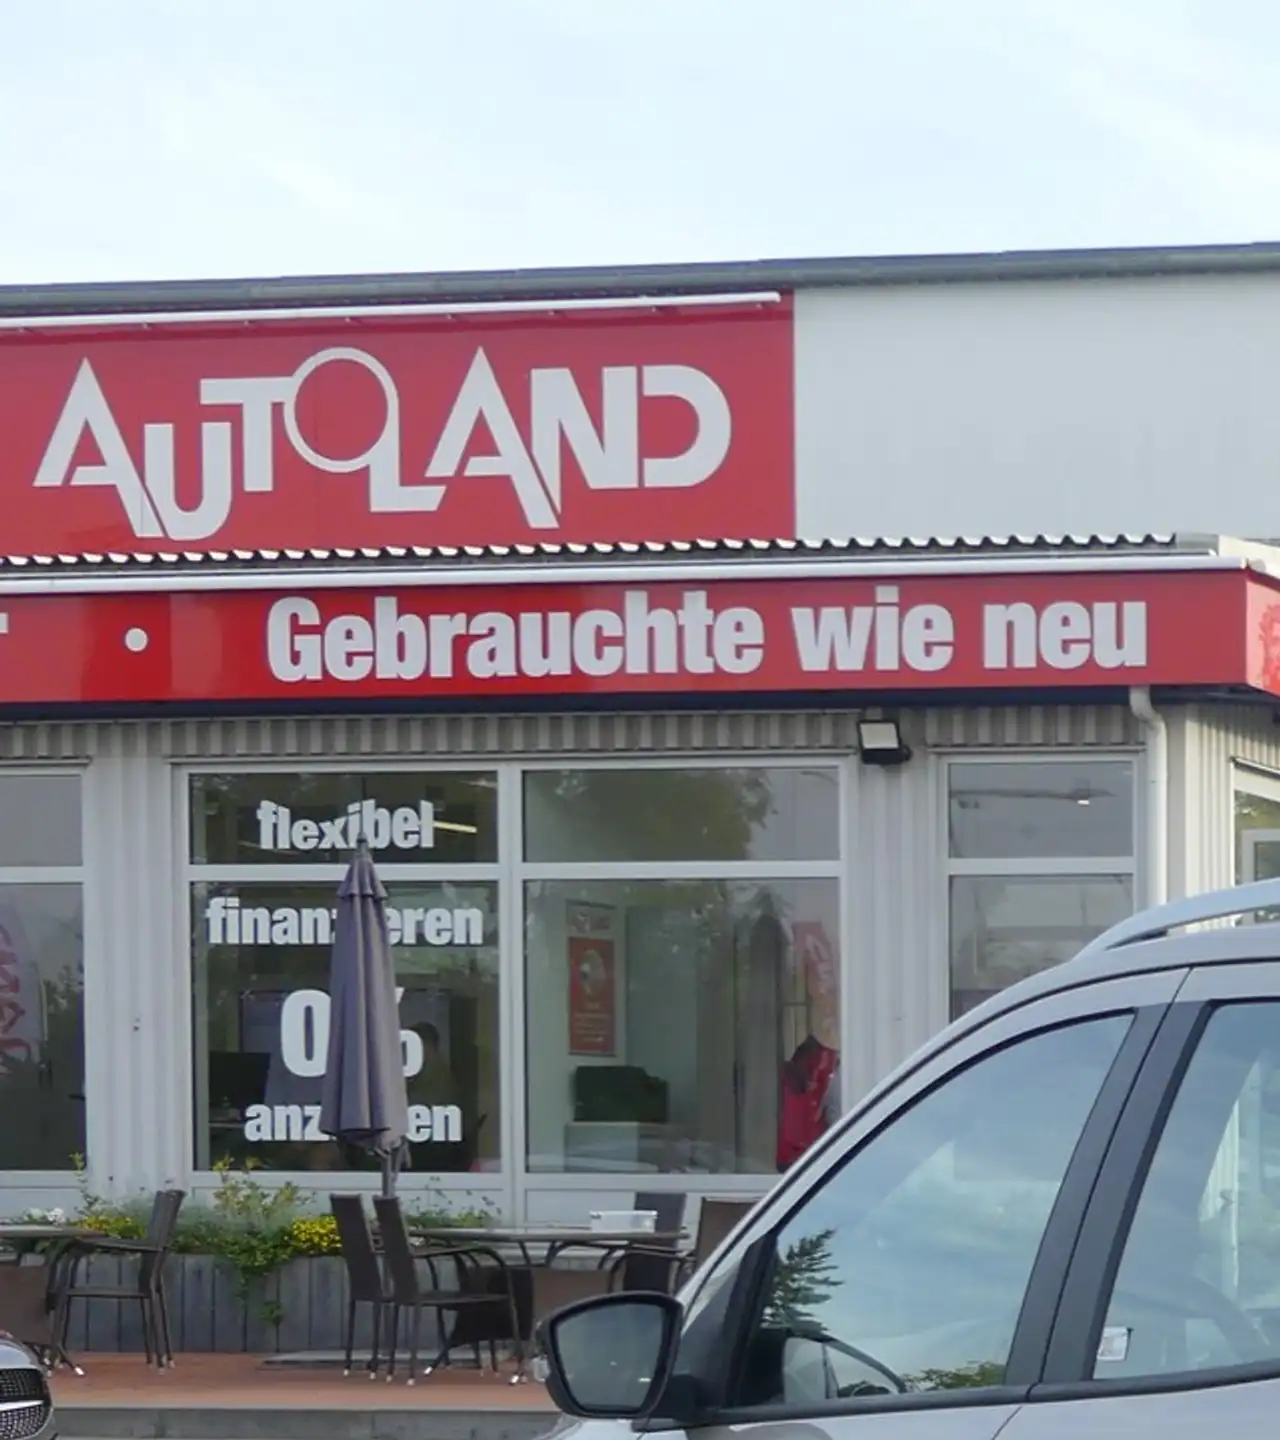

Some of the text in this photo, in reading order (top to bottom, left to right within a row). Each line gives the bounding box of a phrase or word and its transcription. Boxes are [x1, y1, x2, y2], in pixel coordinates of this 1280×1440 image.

[33, 346, 732, 541] AUTOLAND
[267, 586, 1147, 682] Gebrauchte wie neu
[257, 799, 434, 849] flexibel
[205, 896, 484, 945] finaneren
[244, 1104, 463, 1142] anzen
